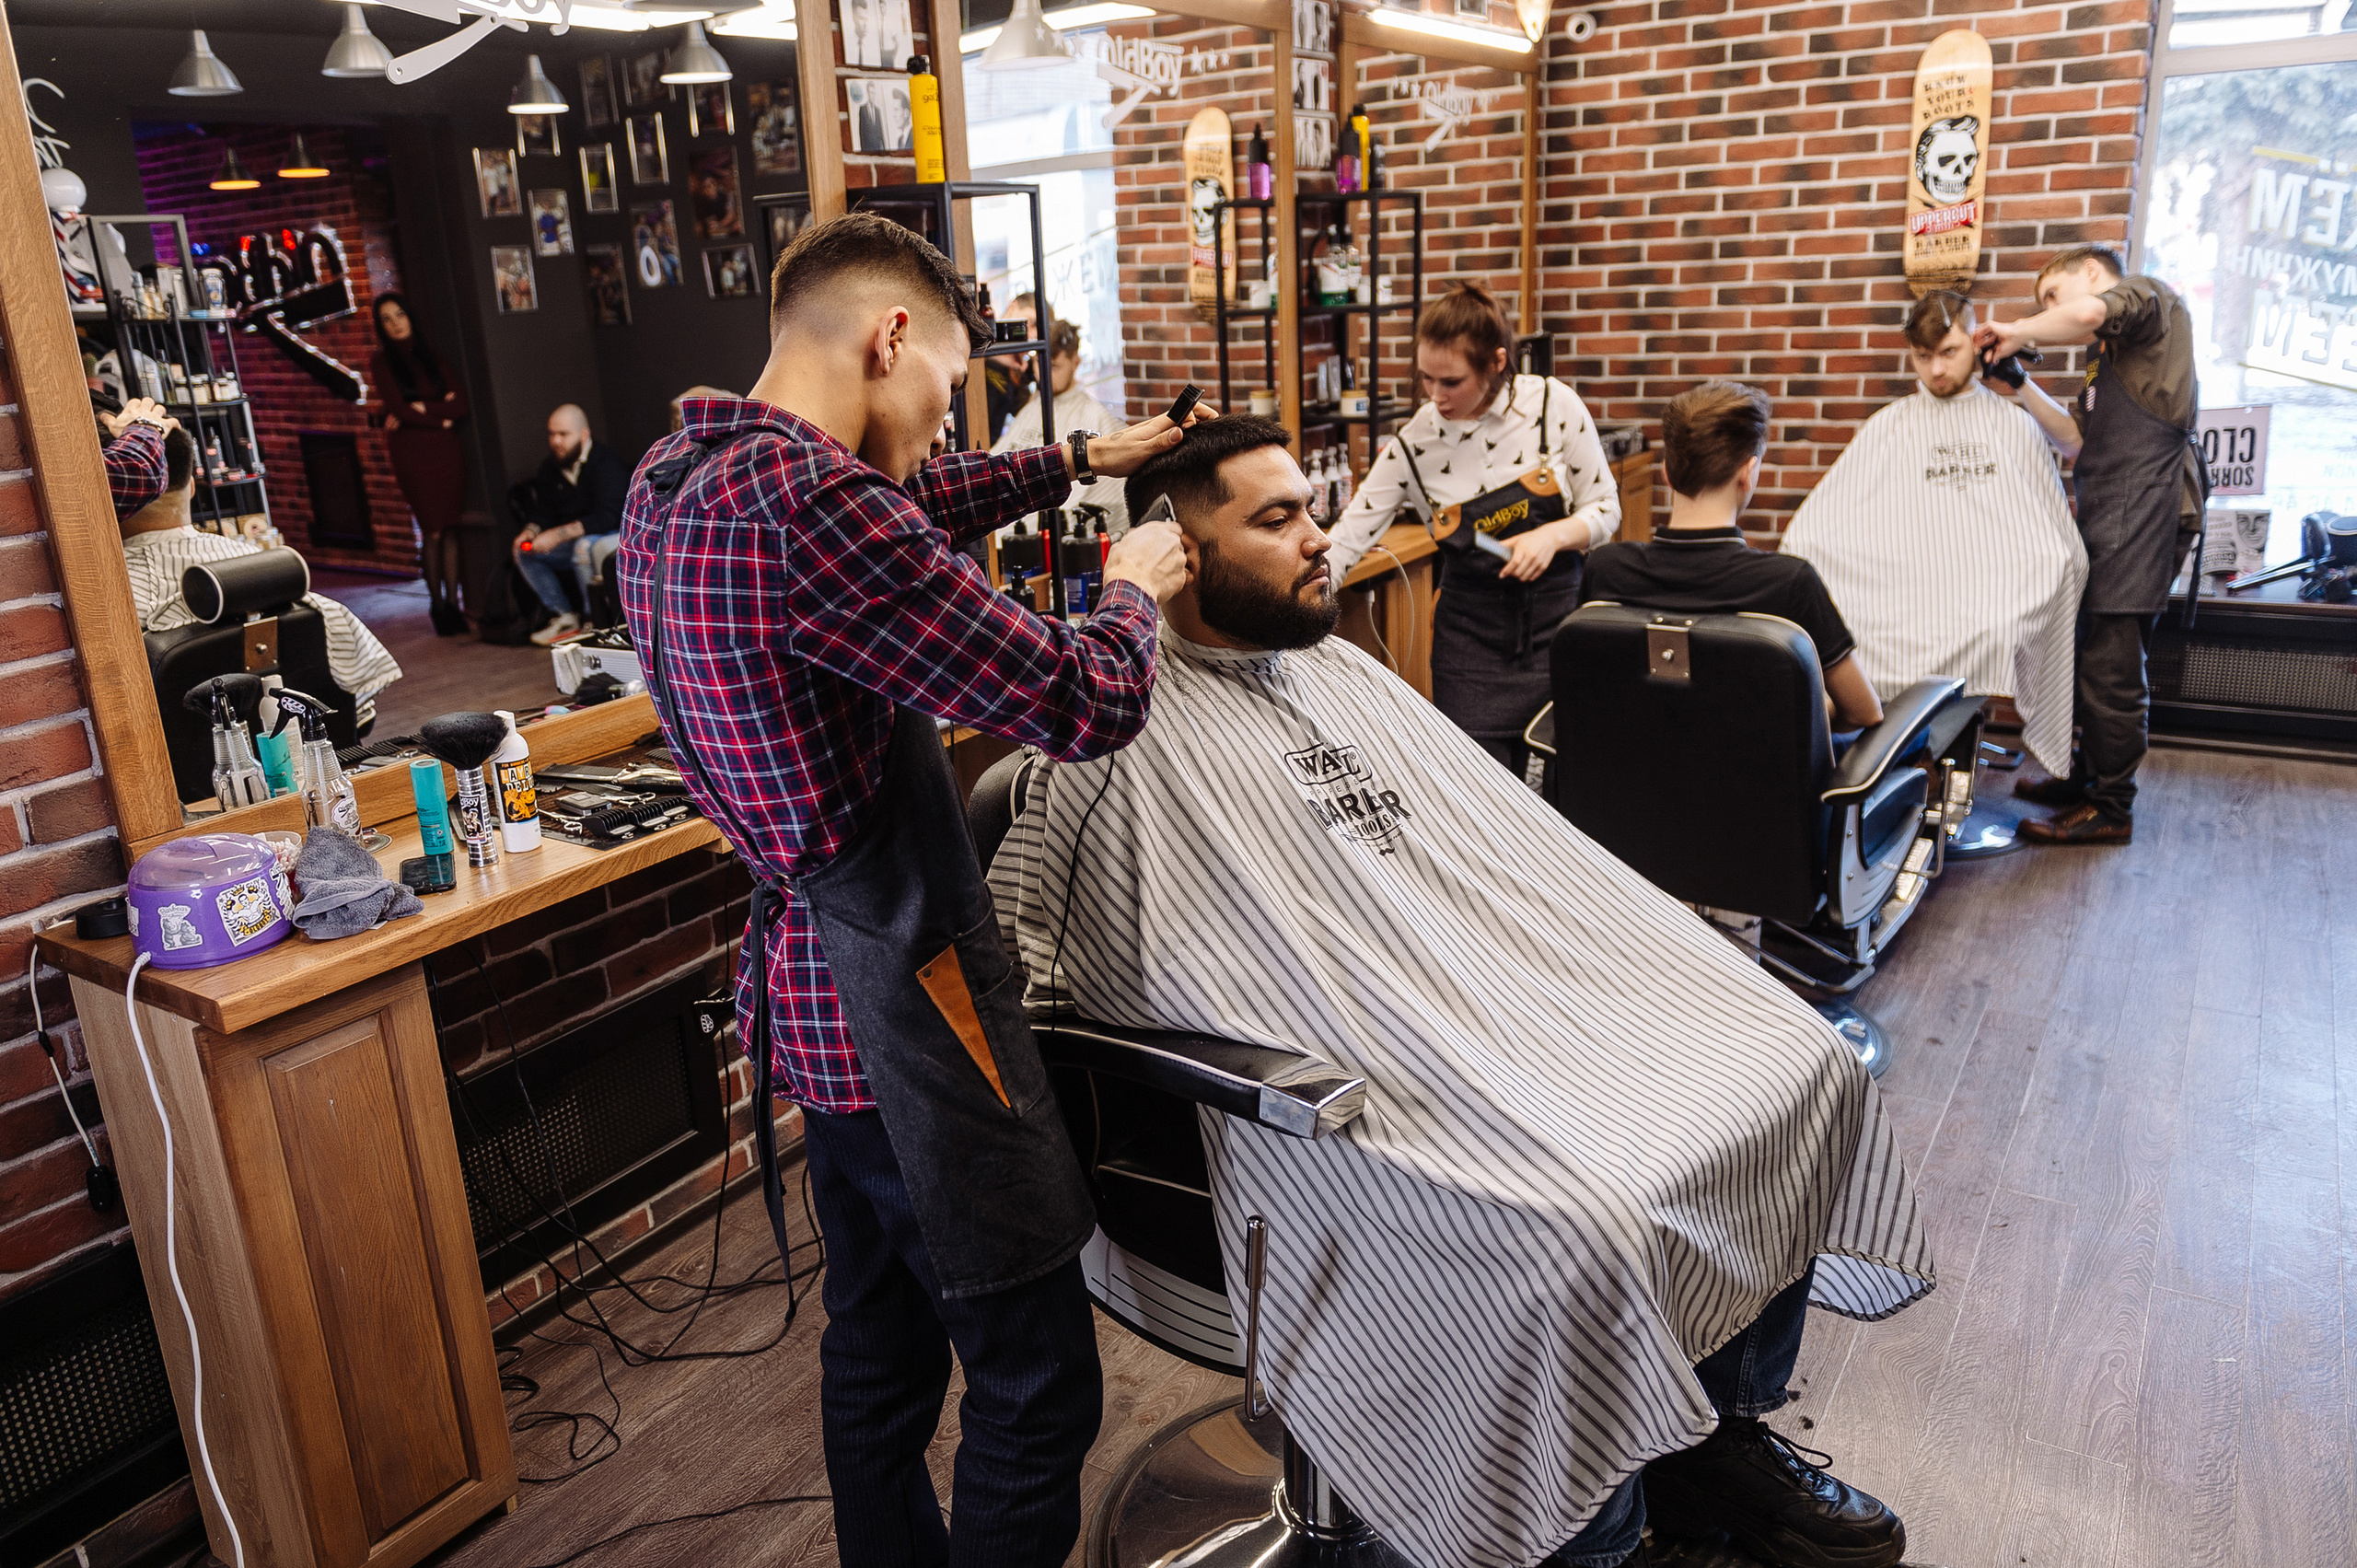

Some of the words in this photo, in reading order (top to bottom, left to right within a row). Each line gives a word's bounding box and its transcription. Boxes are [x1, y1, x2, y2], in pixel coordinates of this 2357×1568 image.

[1910, 203, 1977, 233] UPPERCUT
[2202, 427, 2257, 465] CLO
[2211, 466, 2255, 488] SORR
[505, 775, 534, 794] DELU
